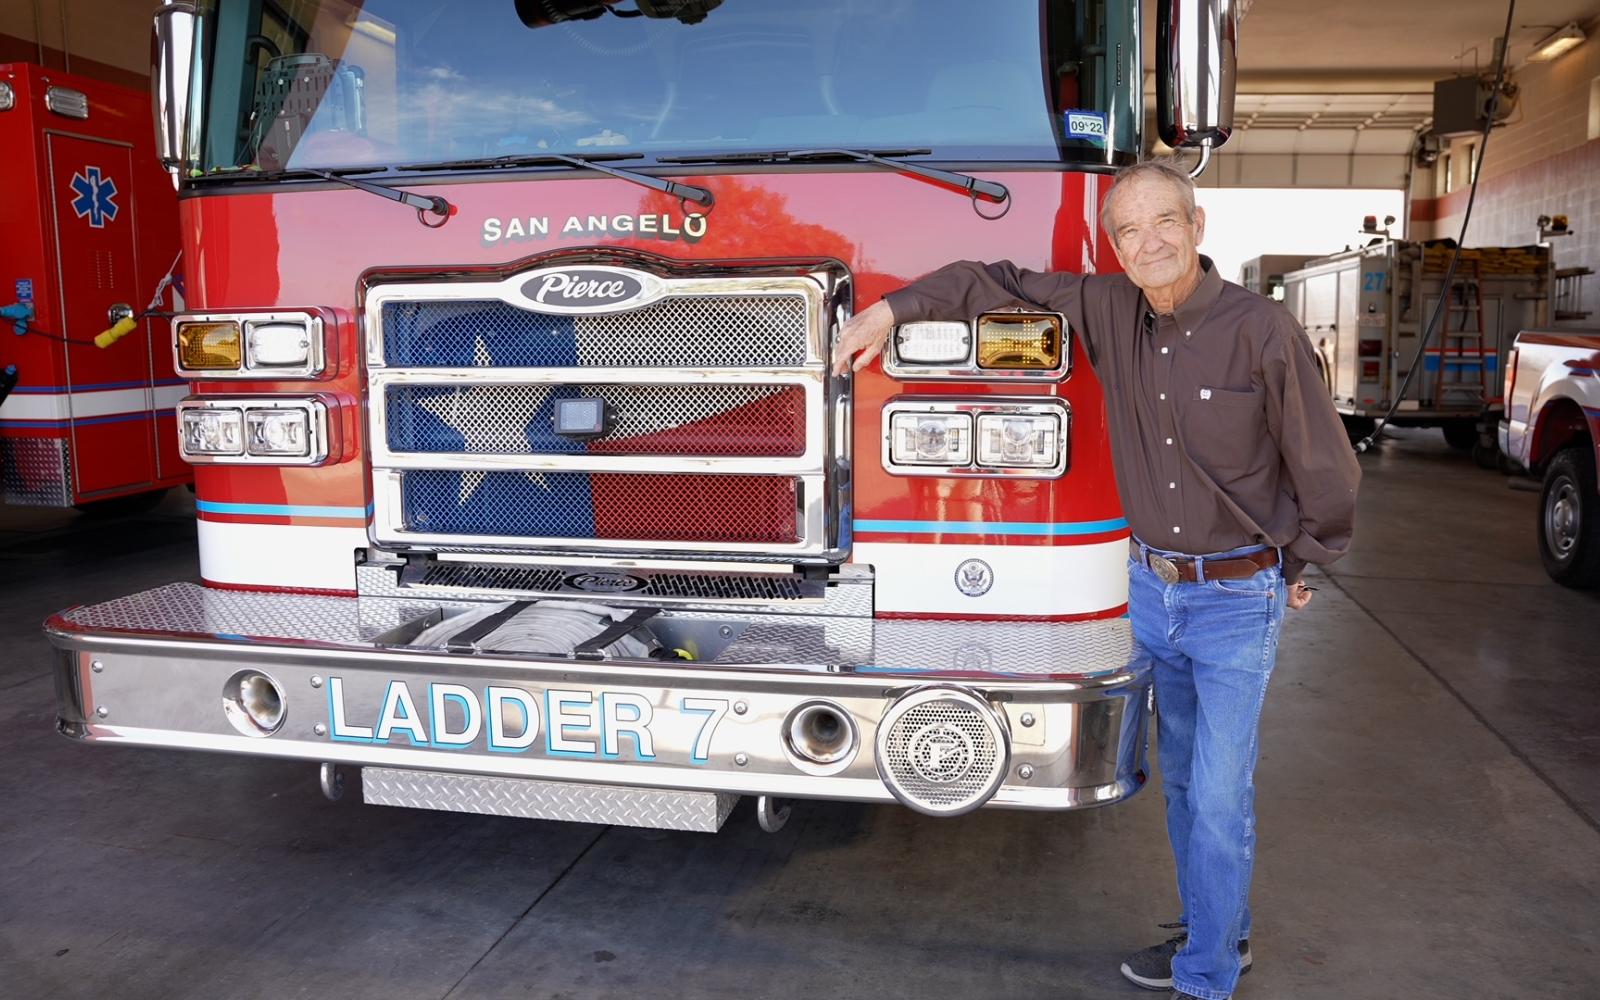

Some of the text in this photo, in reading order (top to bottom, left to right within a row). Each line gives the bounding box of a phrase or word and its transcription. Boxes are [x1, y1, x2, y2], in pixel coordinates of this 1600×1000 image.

[1071, 121, 1102, 133] 09 22
[483, 212, 708, 243] SAN ANGELO
[535, 272, 627, 303] Pierce
[1364, 272, 1386, 291] 27
[327, 676, 730, 764] LADDER 7
